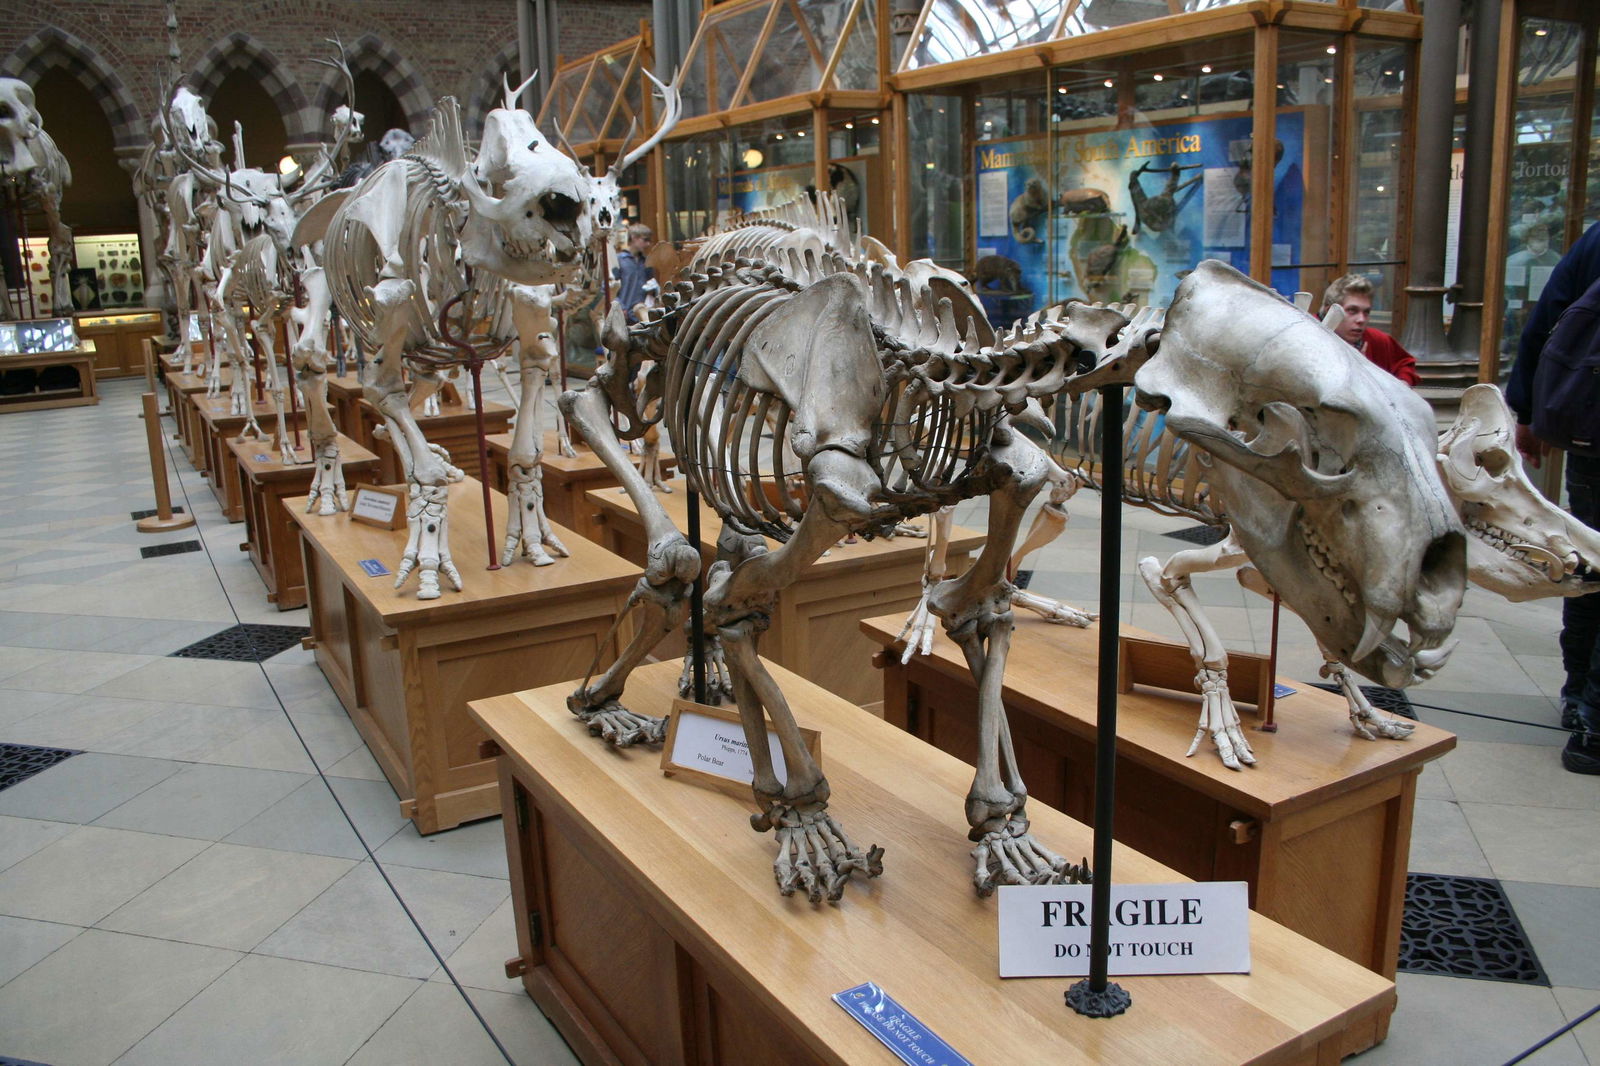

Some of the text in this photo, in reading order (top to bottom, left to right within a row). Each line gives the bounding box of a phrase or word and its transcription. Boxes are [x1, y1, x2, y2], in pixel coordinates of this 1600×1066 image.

[980, 147, 1050, 169] Mamm
[1074, 138, 1119, 163] South
[1124, 132, 1201, 159] America
[1516, 158, 1570, 178] Tortoi
[714, 734, 749, 748] Ursus marit
[697, 753, 724, 767] Polar Bear
[1041, 898, 1203, 928] FRGILE
[1054, 944, 1081, 958] DO
[1129, 942, 1193, 957] TOUCH
[889, 1015, 922, 1041] FRAGILE
[882, 1020, 895, 1032] DO
[894, 1029, 911, 1043] NOT
[908, 1041, 936, 1065] TOUCH
